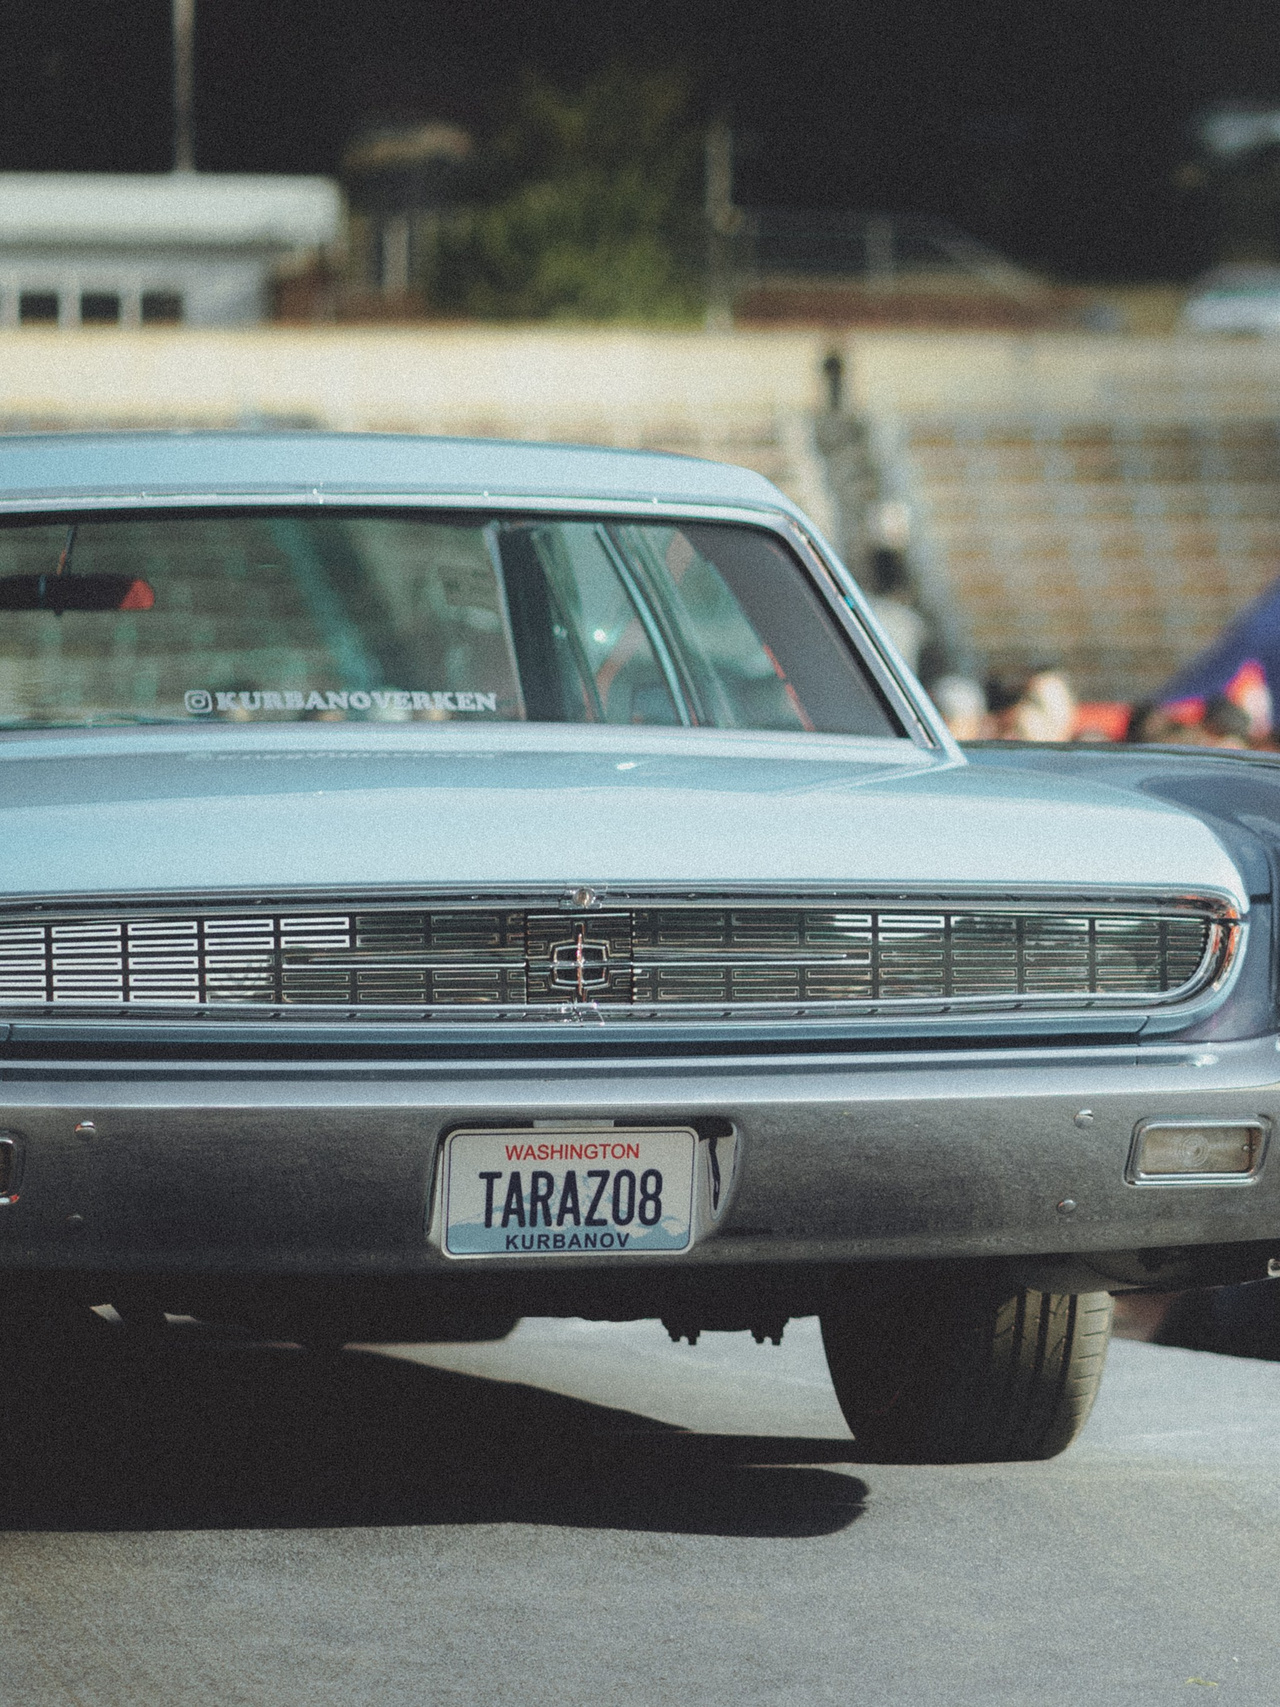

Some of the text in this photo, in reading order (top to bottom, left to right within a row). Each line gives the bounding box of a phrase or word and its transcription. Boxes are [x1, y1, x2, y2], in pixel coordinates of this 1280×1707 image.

[215, 691, 497, 712] KURBANOVERKEN
[505, 1143, 640, 1161] WASHINGTON
[478, 1168, 664, 1229] TARAZ08
[505, 1232, 631, 1250] KURBANOV
